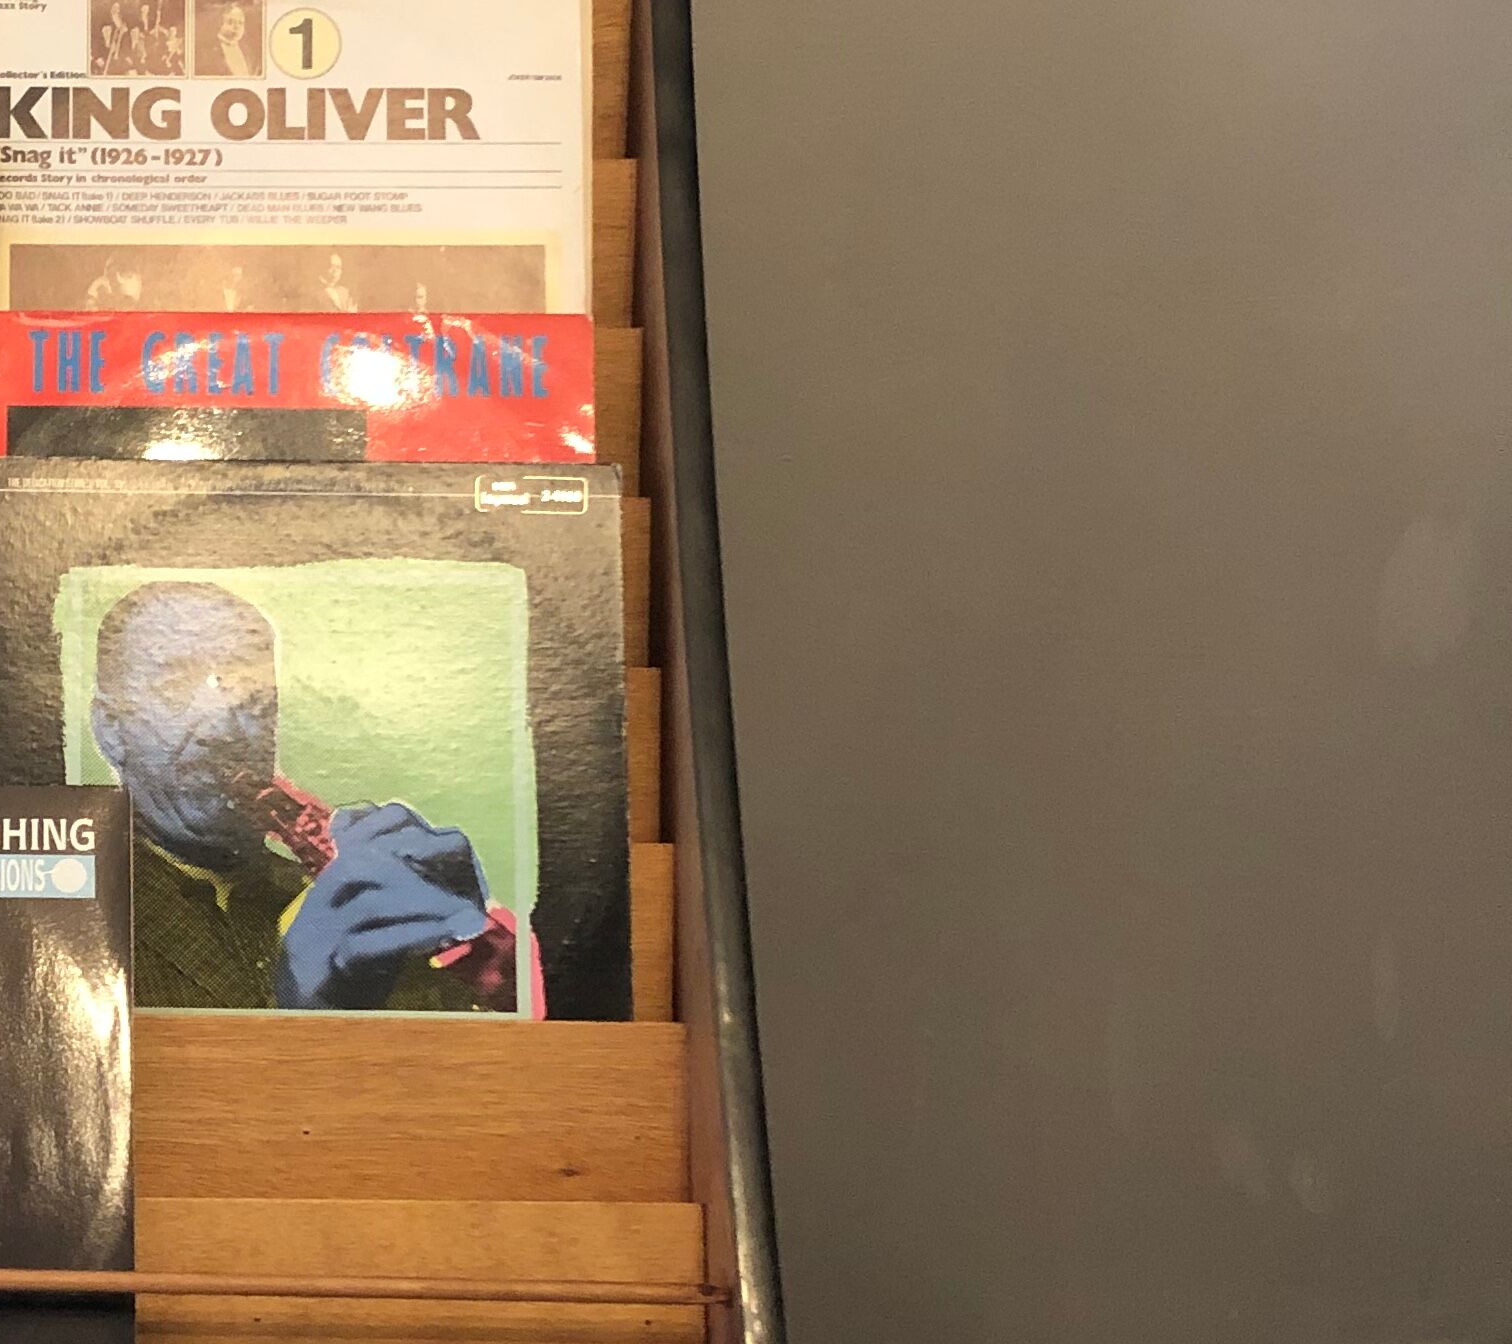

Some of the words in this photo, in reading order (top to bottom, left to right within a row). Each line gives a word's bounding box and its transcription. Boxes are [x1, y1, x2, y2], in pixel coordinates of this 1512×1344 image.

[19, 2, 47, 12] Story
[288, 17, 315, 70] 1
[49, 71, 86, 79] Edition
[210, 86, 482, 142] OLIVER
[40, 174, 74, 186] Story
[75, 174, 87, 183] in
[91, 173, 170, 186] chronological
[174, 173, 208, 183] order
[15, 191, 35, 201] BAD
[42, 191, 70, 201] SNAG
[72, 191, 81, 201] IT
[122, 191, 148, 201] DEEP
[150, 191, 211, 201] HENDERSON
[307, 192, 341, 201] SUGAR
[344, 192, 371, 201] FOOT
[21, 215, 31, 224] IT
[130, 215, 175, 225] SHUFFLE
[28, 330, 106, 393] THE
[141, 330, 285, 396] GREAT
